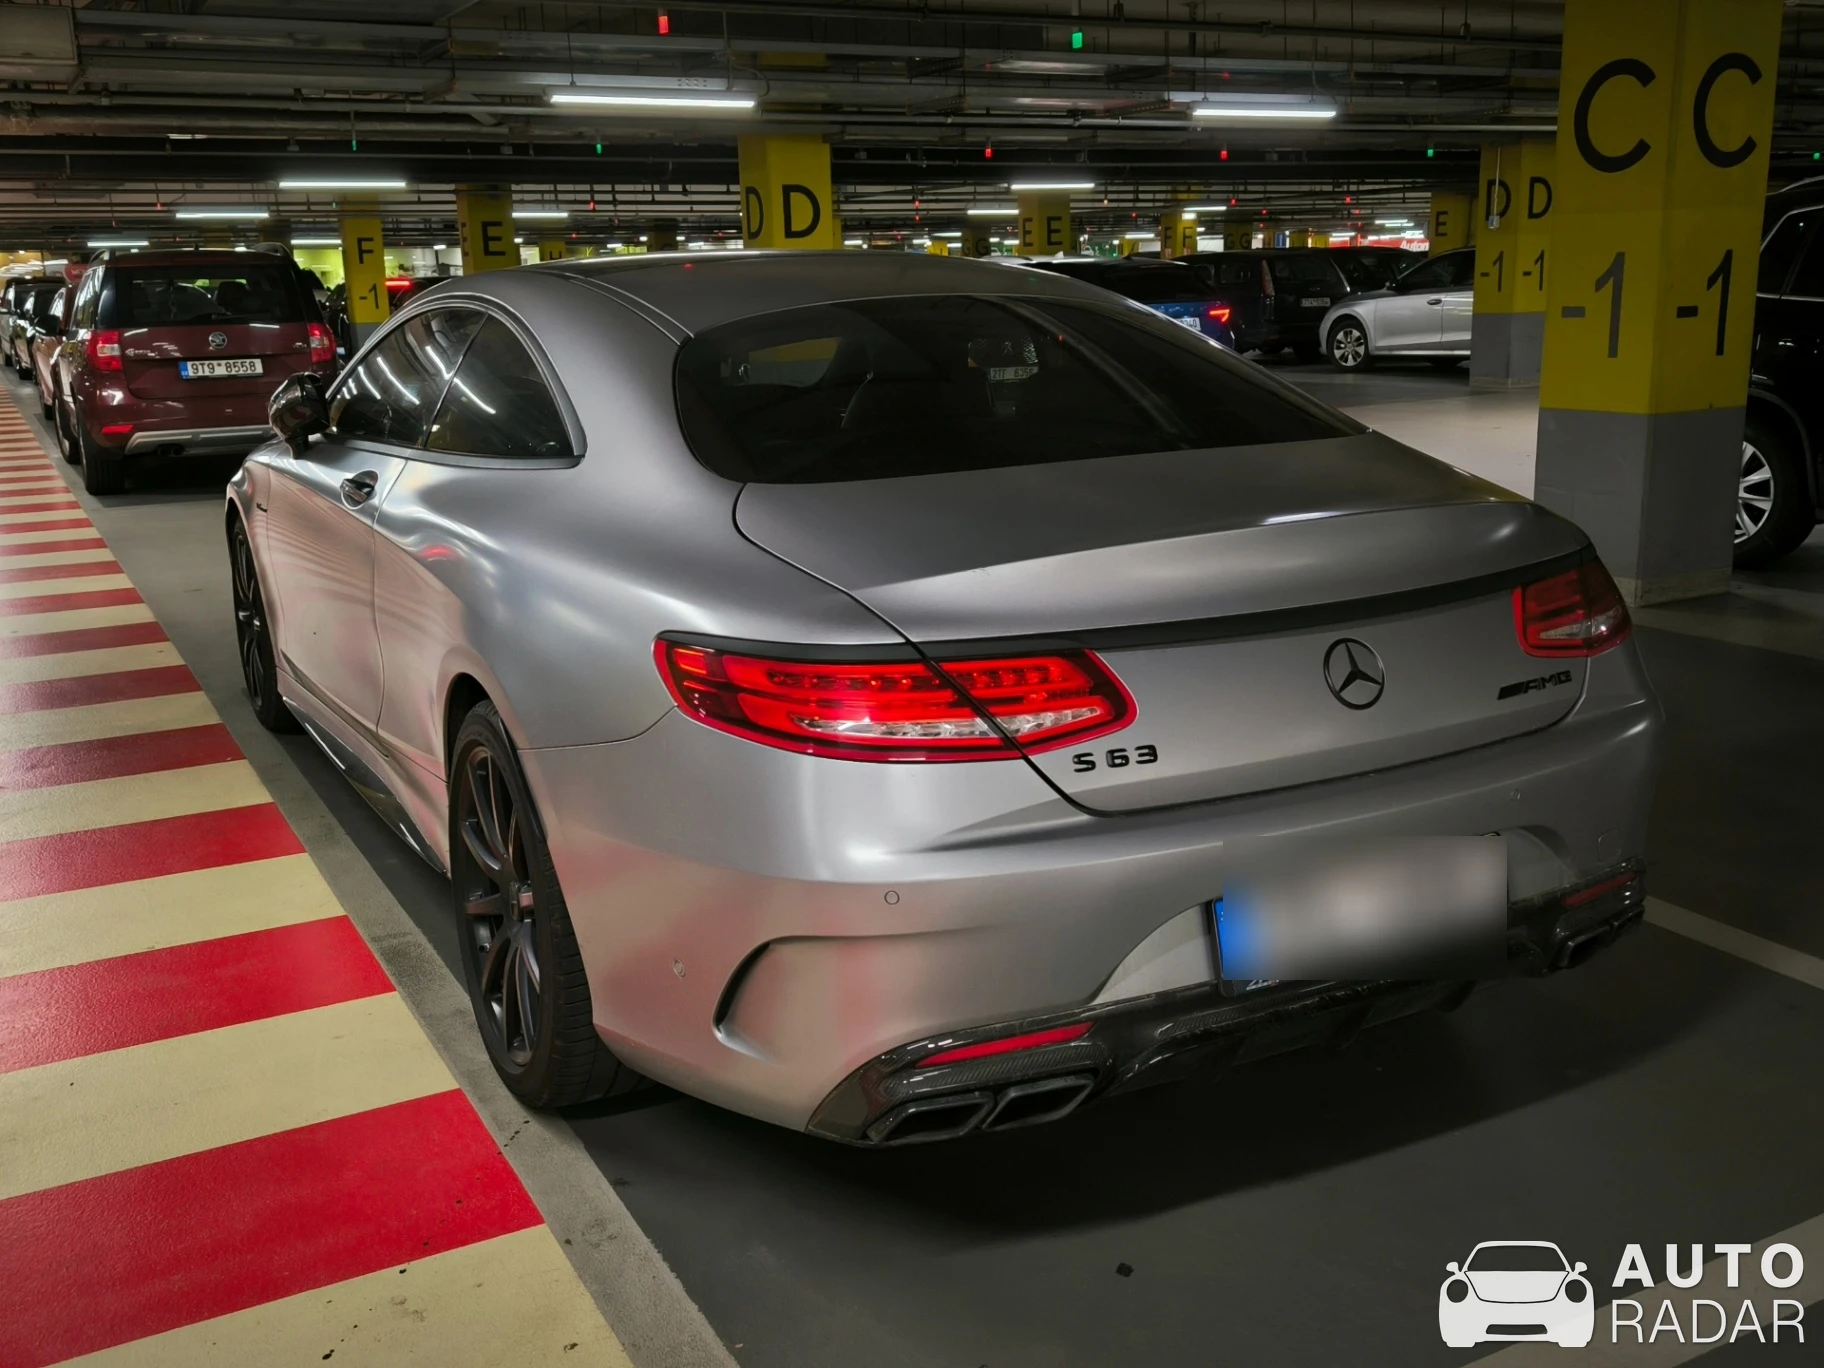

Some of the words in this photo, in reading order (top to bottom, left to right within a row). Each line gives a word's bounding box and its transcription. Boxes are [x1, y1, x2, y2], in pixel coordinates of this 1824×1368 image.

[1574, 58, 1656, 173] C
[1693, 53, 1763, 168] C
[782, 184, 821, 239] D
[1485, 178, 1512, 221] D
[1527, 176, 1553, 219] D
[745, 186, 764, 240] D
[1435, 211, 1448, 237] E
[481, 221, 506, 257] E
[1023, 217, 1034, 247] E
[1047, 216, 1063, 246] E
[1182, 226, 1193, 245] F
[1225, 233, 1235, 249] G
[1239, 233, 1249, 249] G
[356, 237, 374, 264] F
[975, 237, 991, 256] G
[1480, 250, 1504, 292] -1
[1522, 249, 1545, 291] -1
[360, 283, 379, 309] -1
[1561, 251, 1626, 359] -1
[1676, 249, 1734, 356] -1
[190, 361, 216, 376] 9T9
[225, 360, 256, 374] 8558
[1523, 670, 1573, 694] AMG
[1072, 752, 1096, 773] S
[1106, 744, 1158, 768] 63
